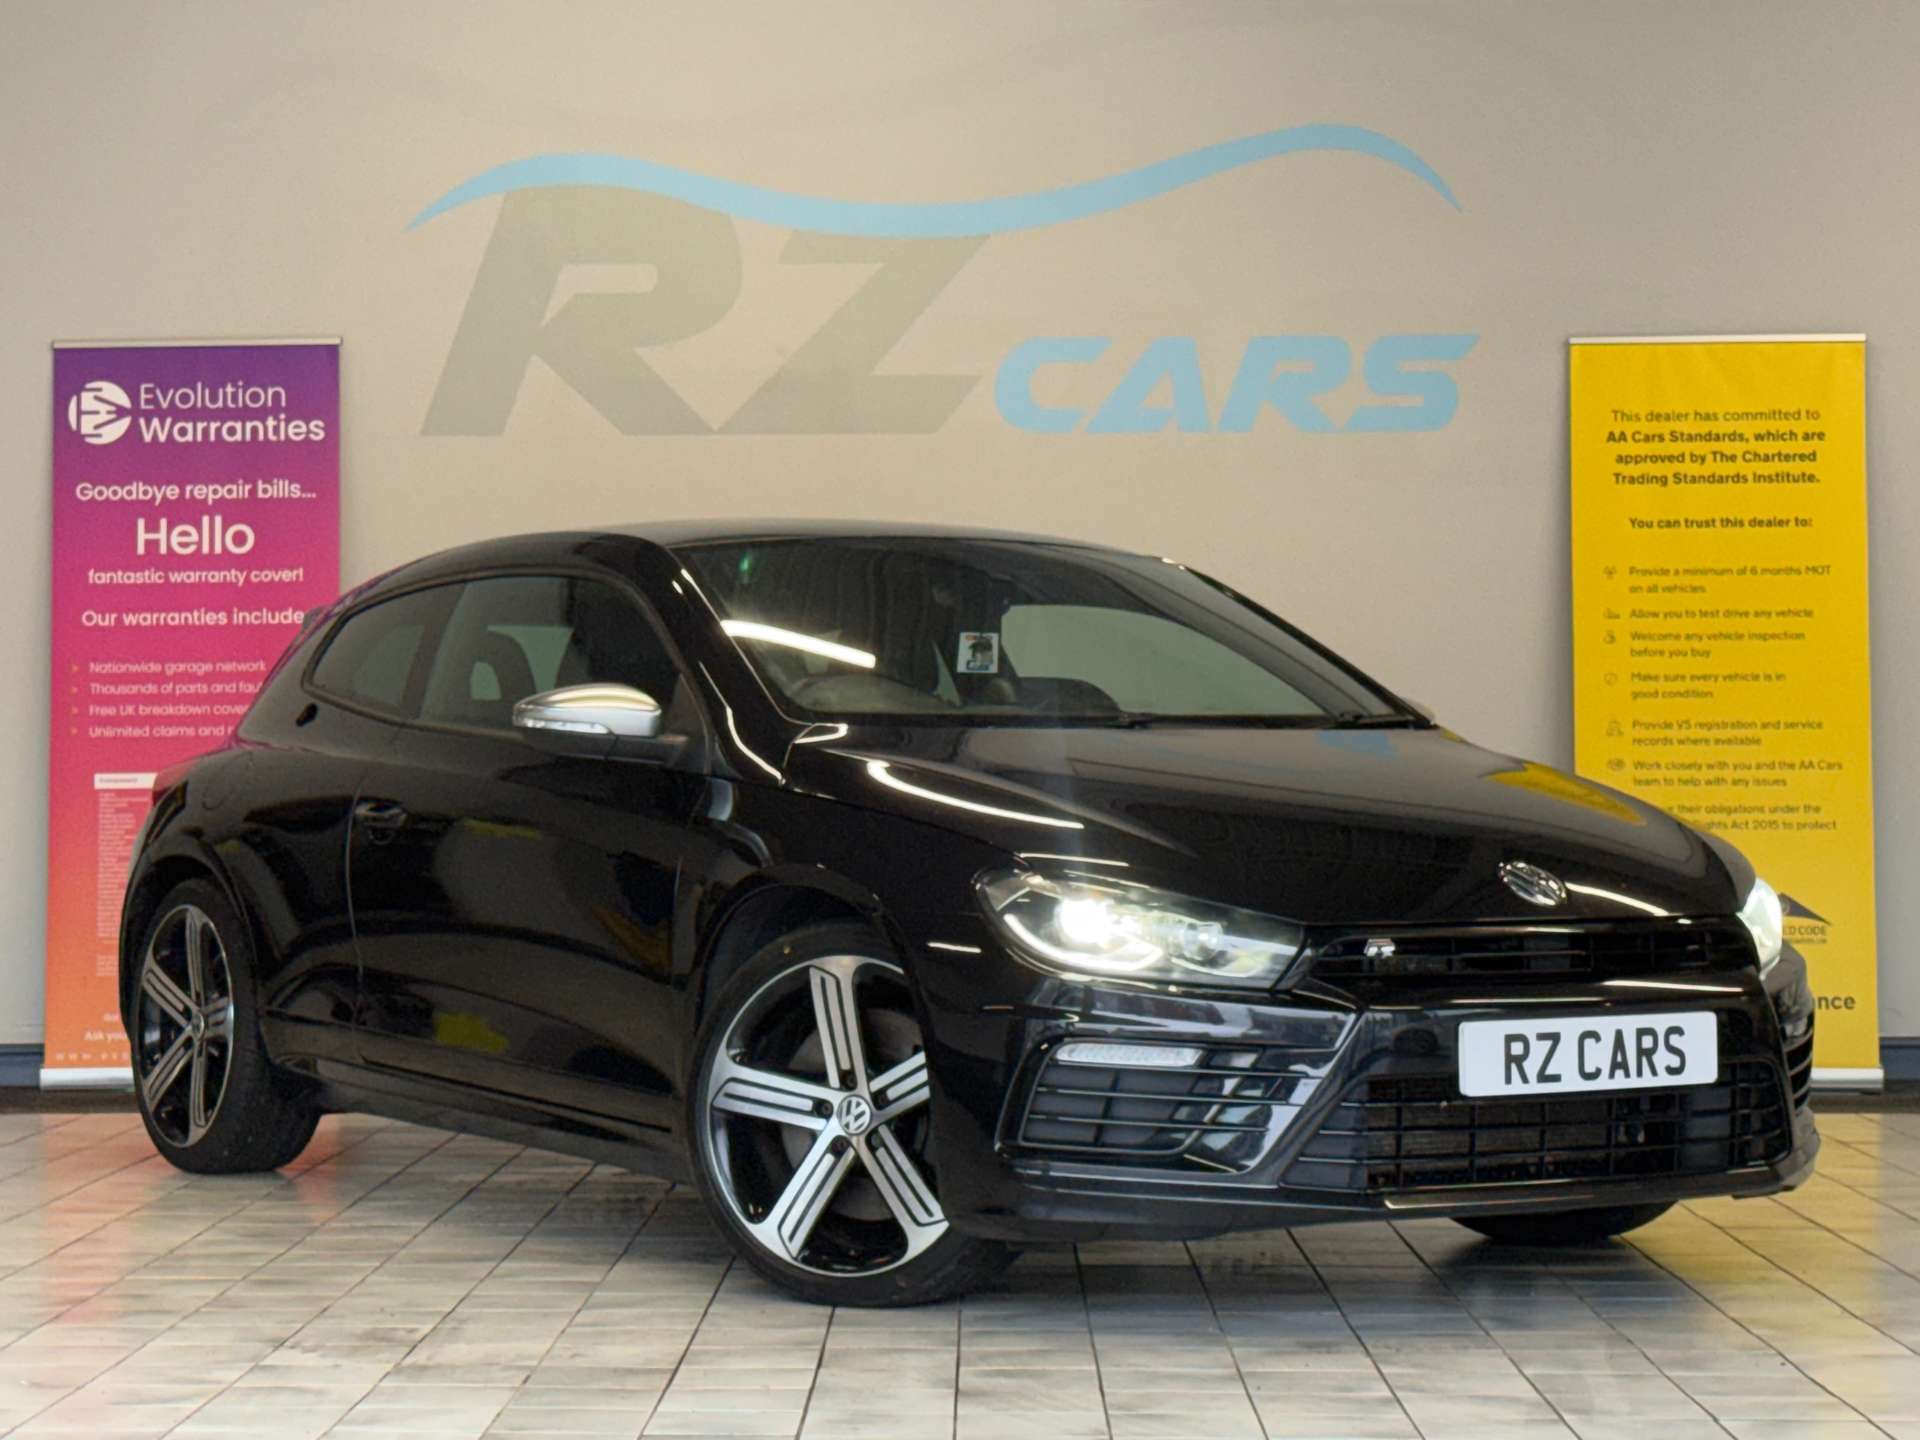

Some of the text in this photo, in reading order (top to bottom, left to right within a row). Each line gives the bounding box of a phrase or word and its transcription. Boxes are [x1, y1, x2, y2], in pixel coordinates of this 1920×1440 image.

[419, 183, 993, 437] RZ
[993, 333, 1481, 434] CARS
[140, 381, 287, 410] Evolution
[1611, 409, 1821, 422] This dealer has committed to
[138, 413, 326, 443] Warranties
[1606, 429, 1826, 444] AA Cars Standards, which are
[1615, 451, 1817, 465] approved by The Chartered
[1613, 472, 1821, 486] Trading Standards Institute.
[76, 479, 317, 506] Goodbye repair bills...
[1628, 517, 1813, 530] You can trust this dealer to:
[136, 514, 255, 555] Hello
[88, 567, 304, 587] fantastic warranty cover!
[1629, 566, 1671, 577] Provide
[1682, 566, 1733, 577] minimum
[1735, 565, 1748, 576] of
[1760, 565, 1802, 576] months
[1804, 564, 1831, 575] MOT
[1629, 583, 1706, 594] on all vehicles
[82, 607, 305, 627] Our warranties include
[1629, 607, 1814, 621] Allow you to test drive any vehicle
[1630, 630, 1806, 644] Welcome any vehicle inspection
[1630, 648, 1711, 660] before you buy
[89, 659, 266, 676] Nationwide garage network
[1631, 671, 1786, 684] Make sure every vehicle is in
[90, 683, 159, 695] Thousands
[161, 683, 173, 695] of
[176, 684, 208, 697] parts
[210, 681, 237, 694] and
[1631, 688, 1713, 701] good condition
[89, 704, 117, 716] Free
[119, 704, 135, 716] UK
[138, 704, 210, 716] breakdown
[89, 726, 150, 738] Unlimited
[153, 725, 196, 737] claims
[198, 725, 225, 737] and
[1632, 719, 1674, 730] Provide
[1694, 719, 1757, 732] registration
[1760, 719, 1781, 730] and
[1783, 719, 1823, 730] service
[1632, 735, 1761, 746] records where available
[1633, 759, 1843, 773] Work closely with you and the AA Cars
[1633, 776, 1787, 789] team to help with any issues
[1704, 803, 1765, 816] obligations
[1768, 803, 1801, 814] under
[1803, 803, 1821, 814] the
[1730, 820, 1749, 831] Act
[1752, 820, 1780, 831] 2015
[1782, 820, 1793, 830] to
[1796, 820, 1837, 832] protect
[1504, 1025, 1687, 1085] RZ CARS
